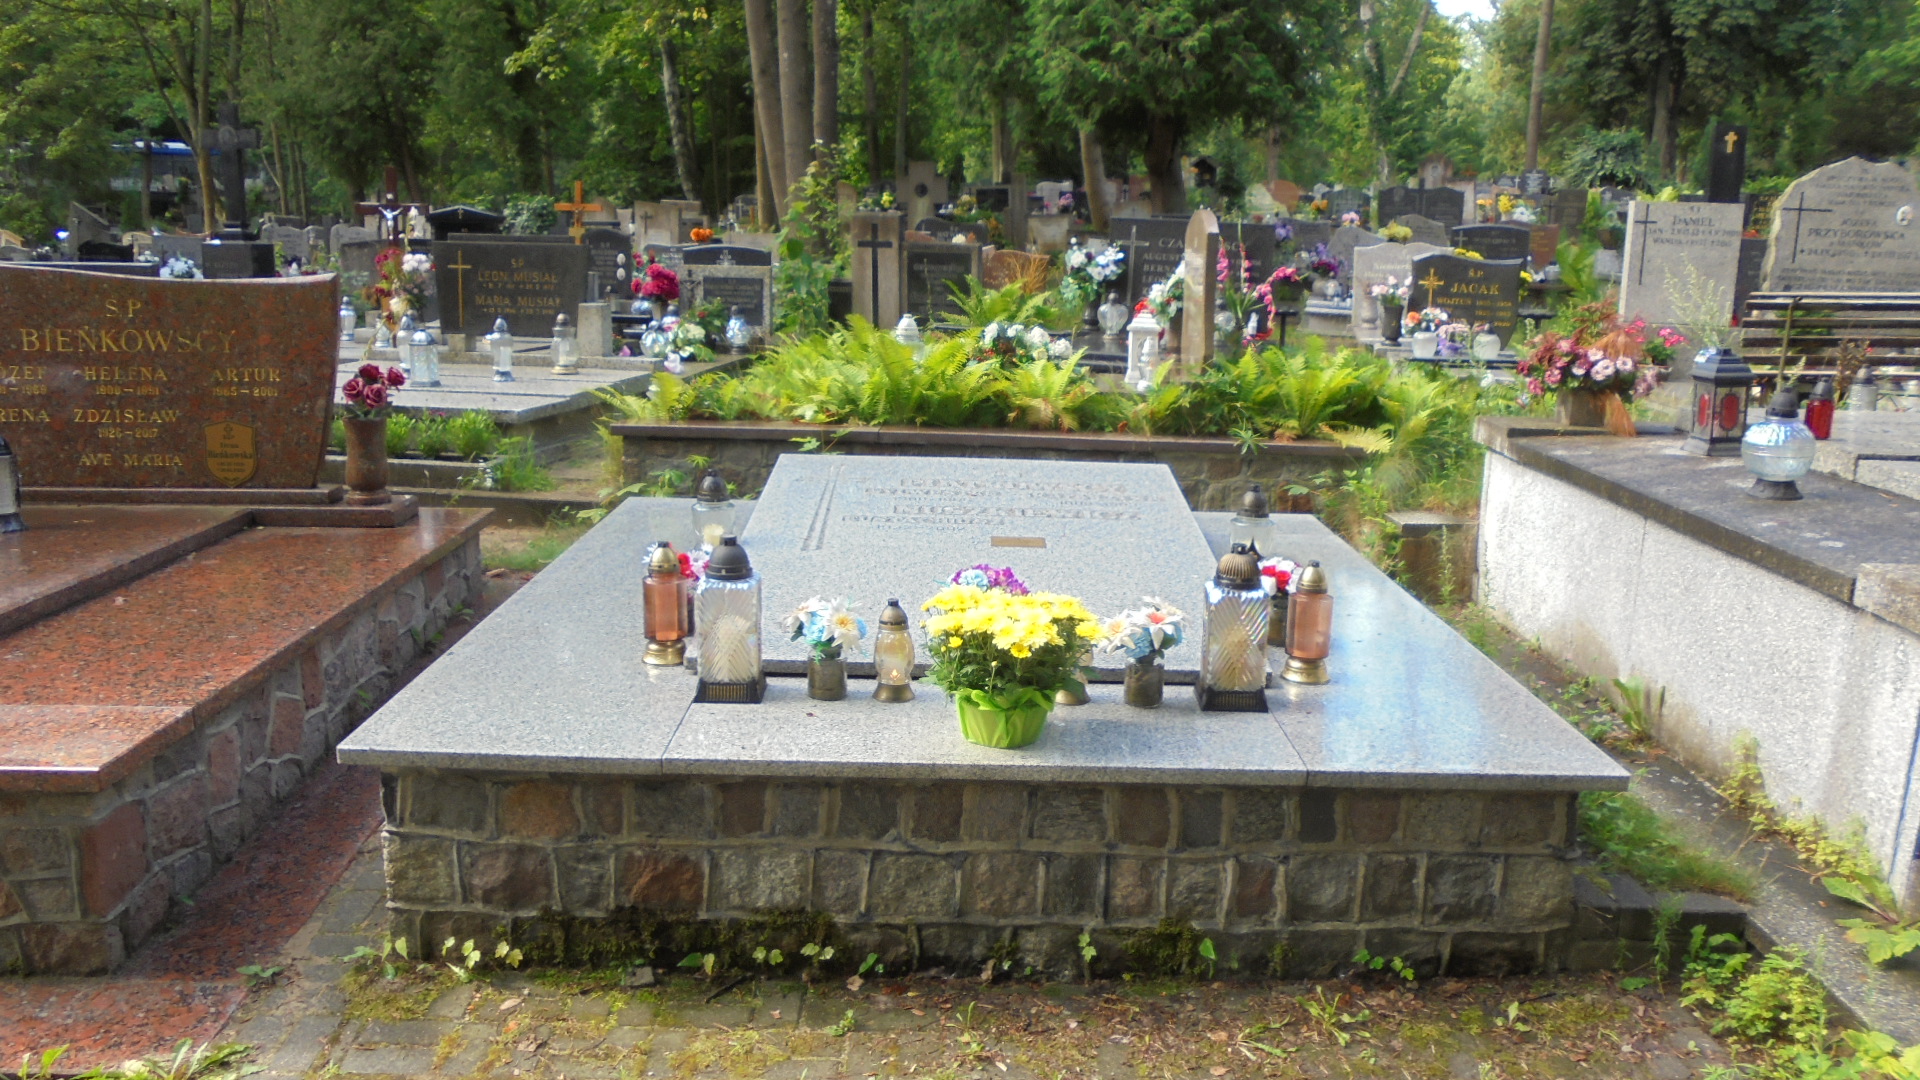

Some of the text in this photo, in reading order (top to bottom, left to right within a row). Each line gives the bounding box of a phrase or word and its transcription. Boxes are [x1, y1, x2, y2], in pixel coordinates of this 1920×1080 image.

[1450, 282, 1500, 295] JACAK
[20, 325, 237, 353] BIEŃKOWSCY
[84, 366, 168, 381] HELENA
[211, 367, 281, 382] ARTUR
[73, 408, 180, 424] ZDZISŁAW
[79, 453, 183, 466] AVE MARIA
